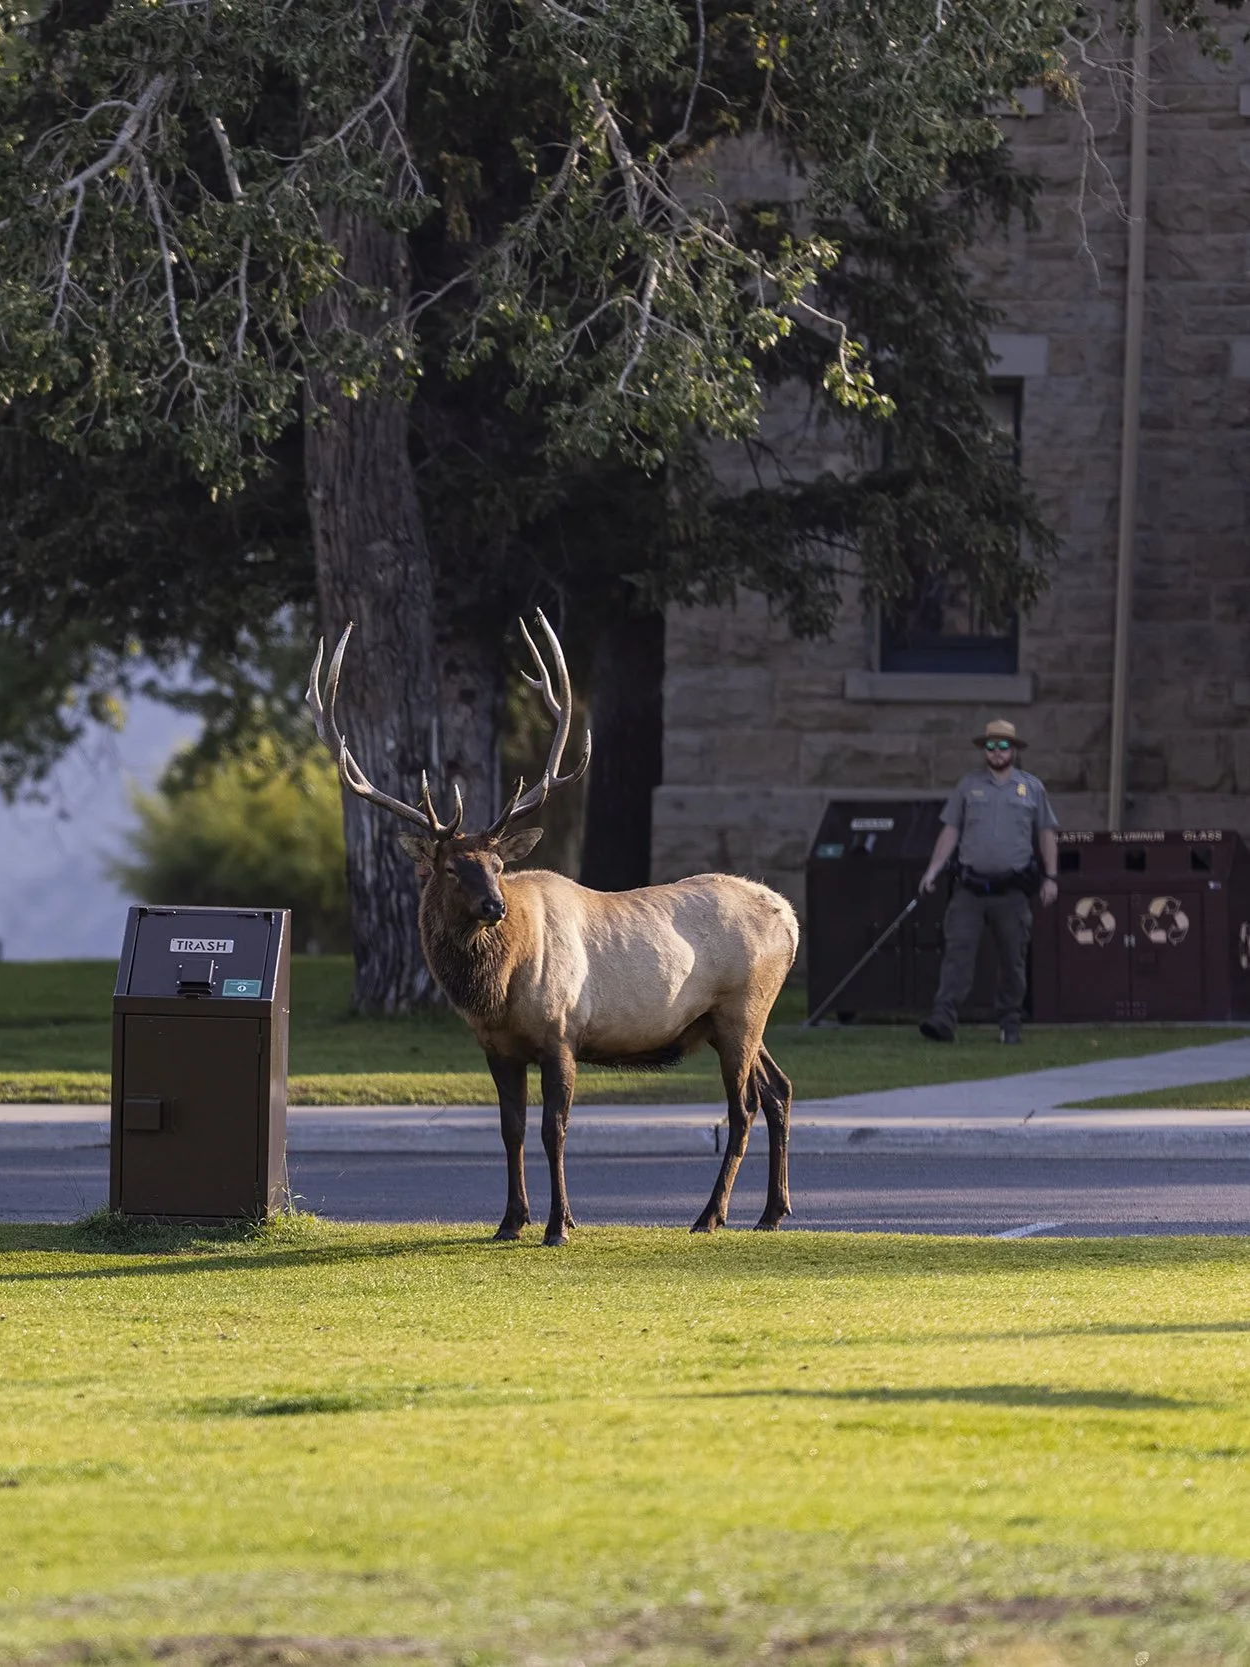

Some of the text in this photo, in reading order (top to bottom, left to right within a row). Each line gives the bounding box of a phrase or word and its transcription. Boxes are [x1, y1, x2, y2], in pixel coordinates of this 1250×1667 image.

[1053, 829, 1223, 843] LASTIC ALUMINUM GLASS
[177, 940, 227, 951] TRASH
